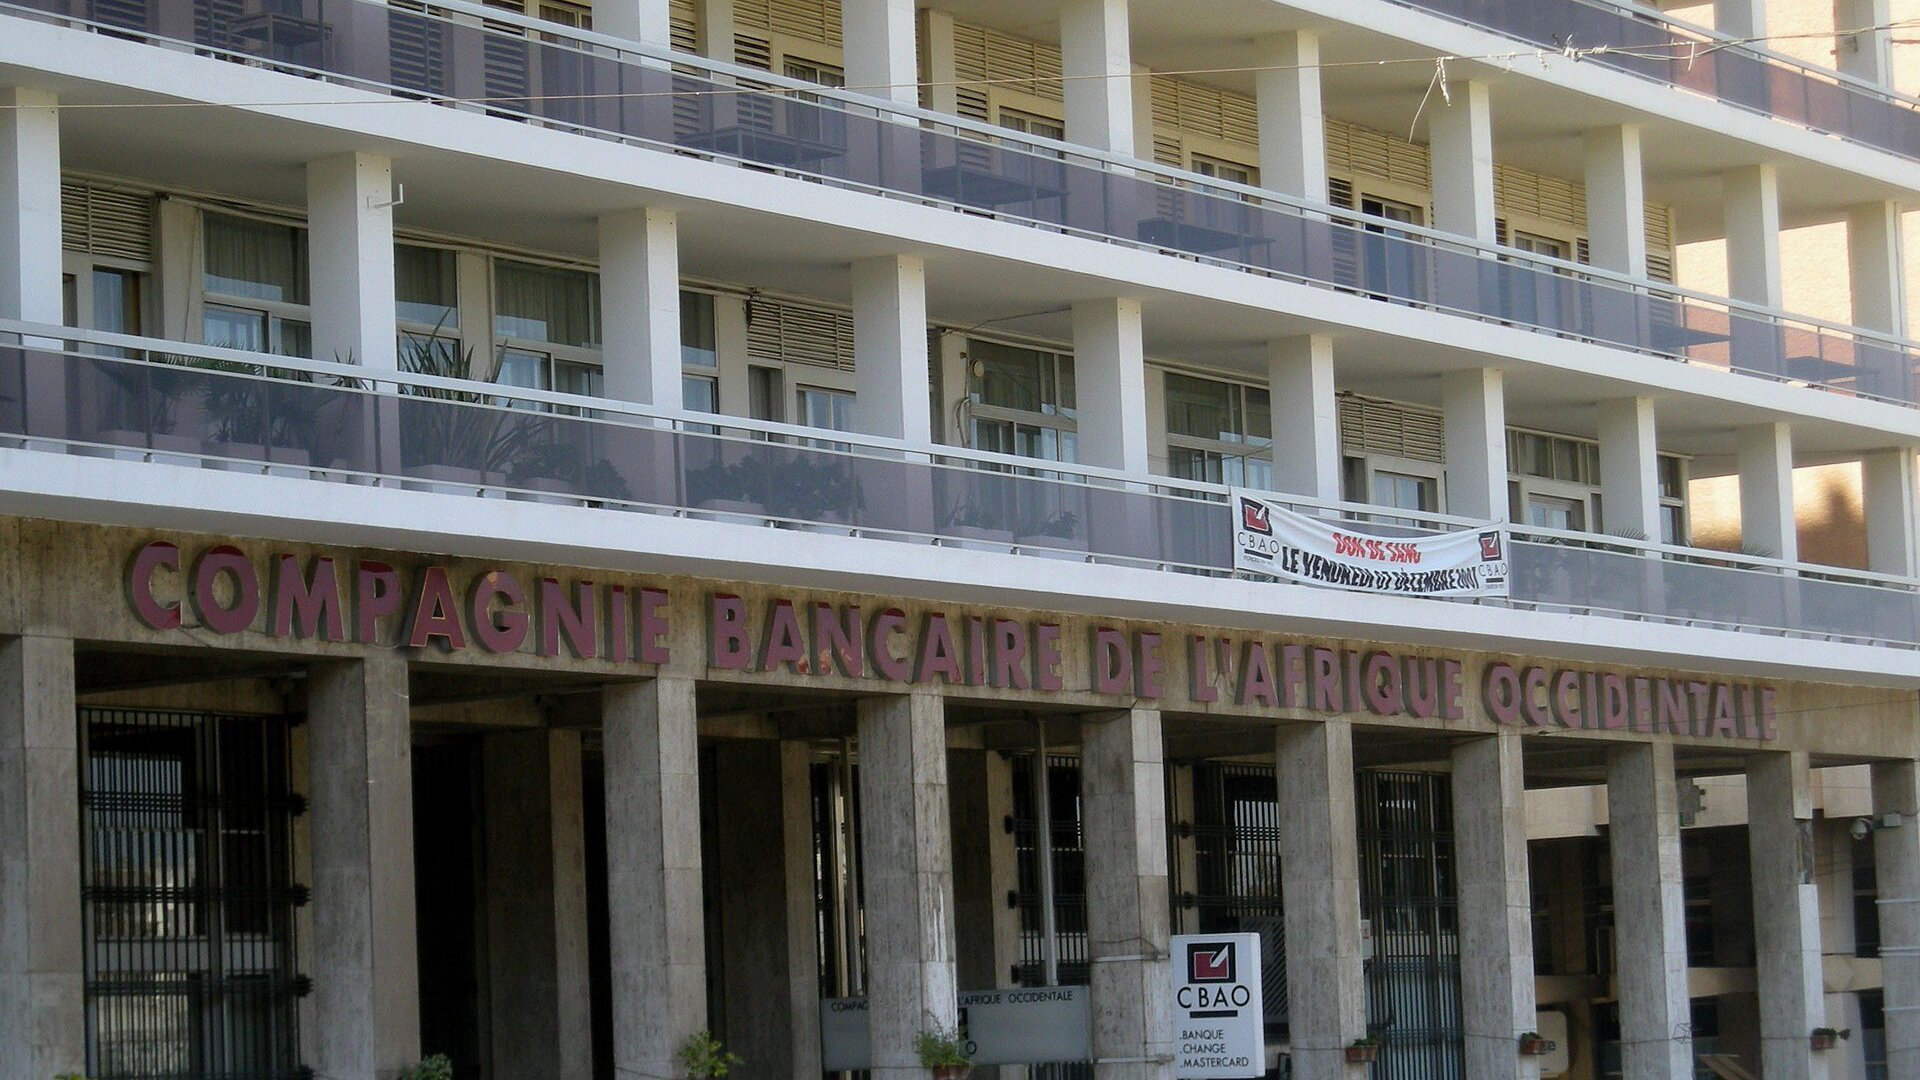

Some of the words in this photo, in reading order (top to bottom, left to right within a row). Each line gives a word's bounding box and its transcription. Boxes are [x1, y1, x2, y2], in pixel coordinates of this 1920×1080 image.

[1237, 531, 1280, 554] CBAO
[1332, 532, 1366, 558] DON
[1366, 539, 1386, 561] DE
[1385, 542, 1422, 564] SANG
[1282, 546, 1300, 574] LE
[1302, 551, 1374, 588] VENDREDI
[1478, 562, 1508, 577] CBAO
[126, 540, 671, 664] COMPAGNIE
[707, 592, 1064, 691] BANCAIRE
[1092, 626, 1164, 698] DE
[1187, 634, 1465, 721] L'AFRIQUE
[1482, 661, 1778, 741] OCCIDENTALE
[1008, 990, 1073, 1004] OCCIDENTALE
[1177, 985, 1250, 1009] CBAO
